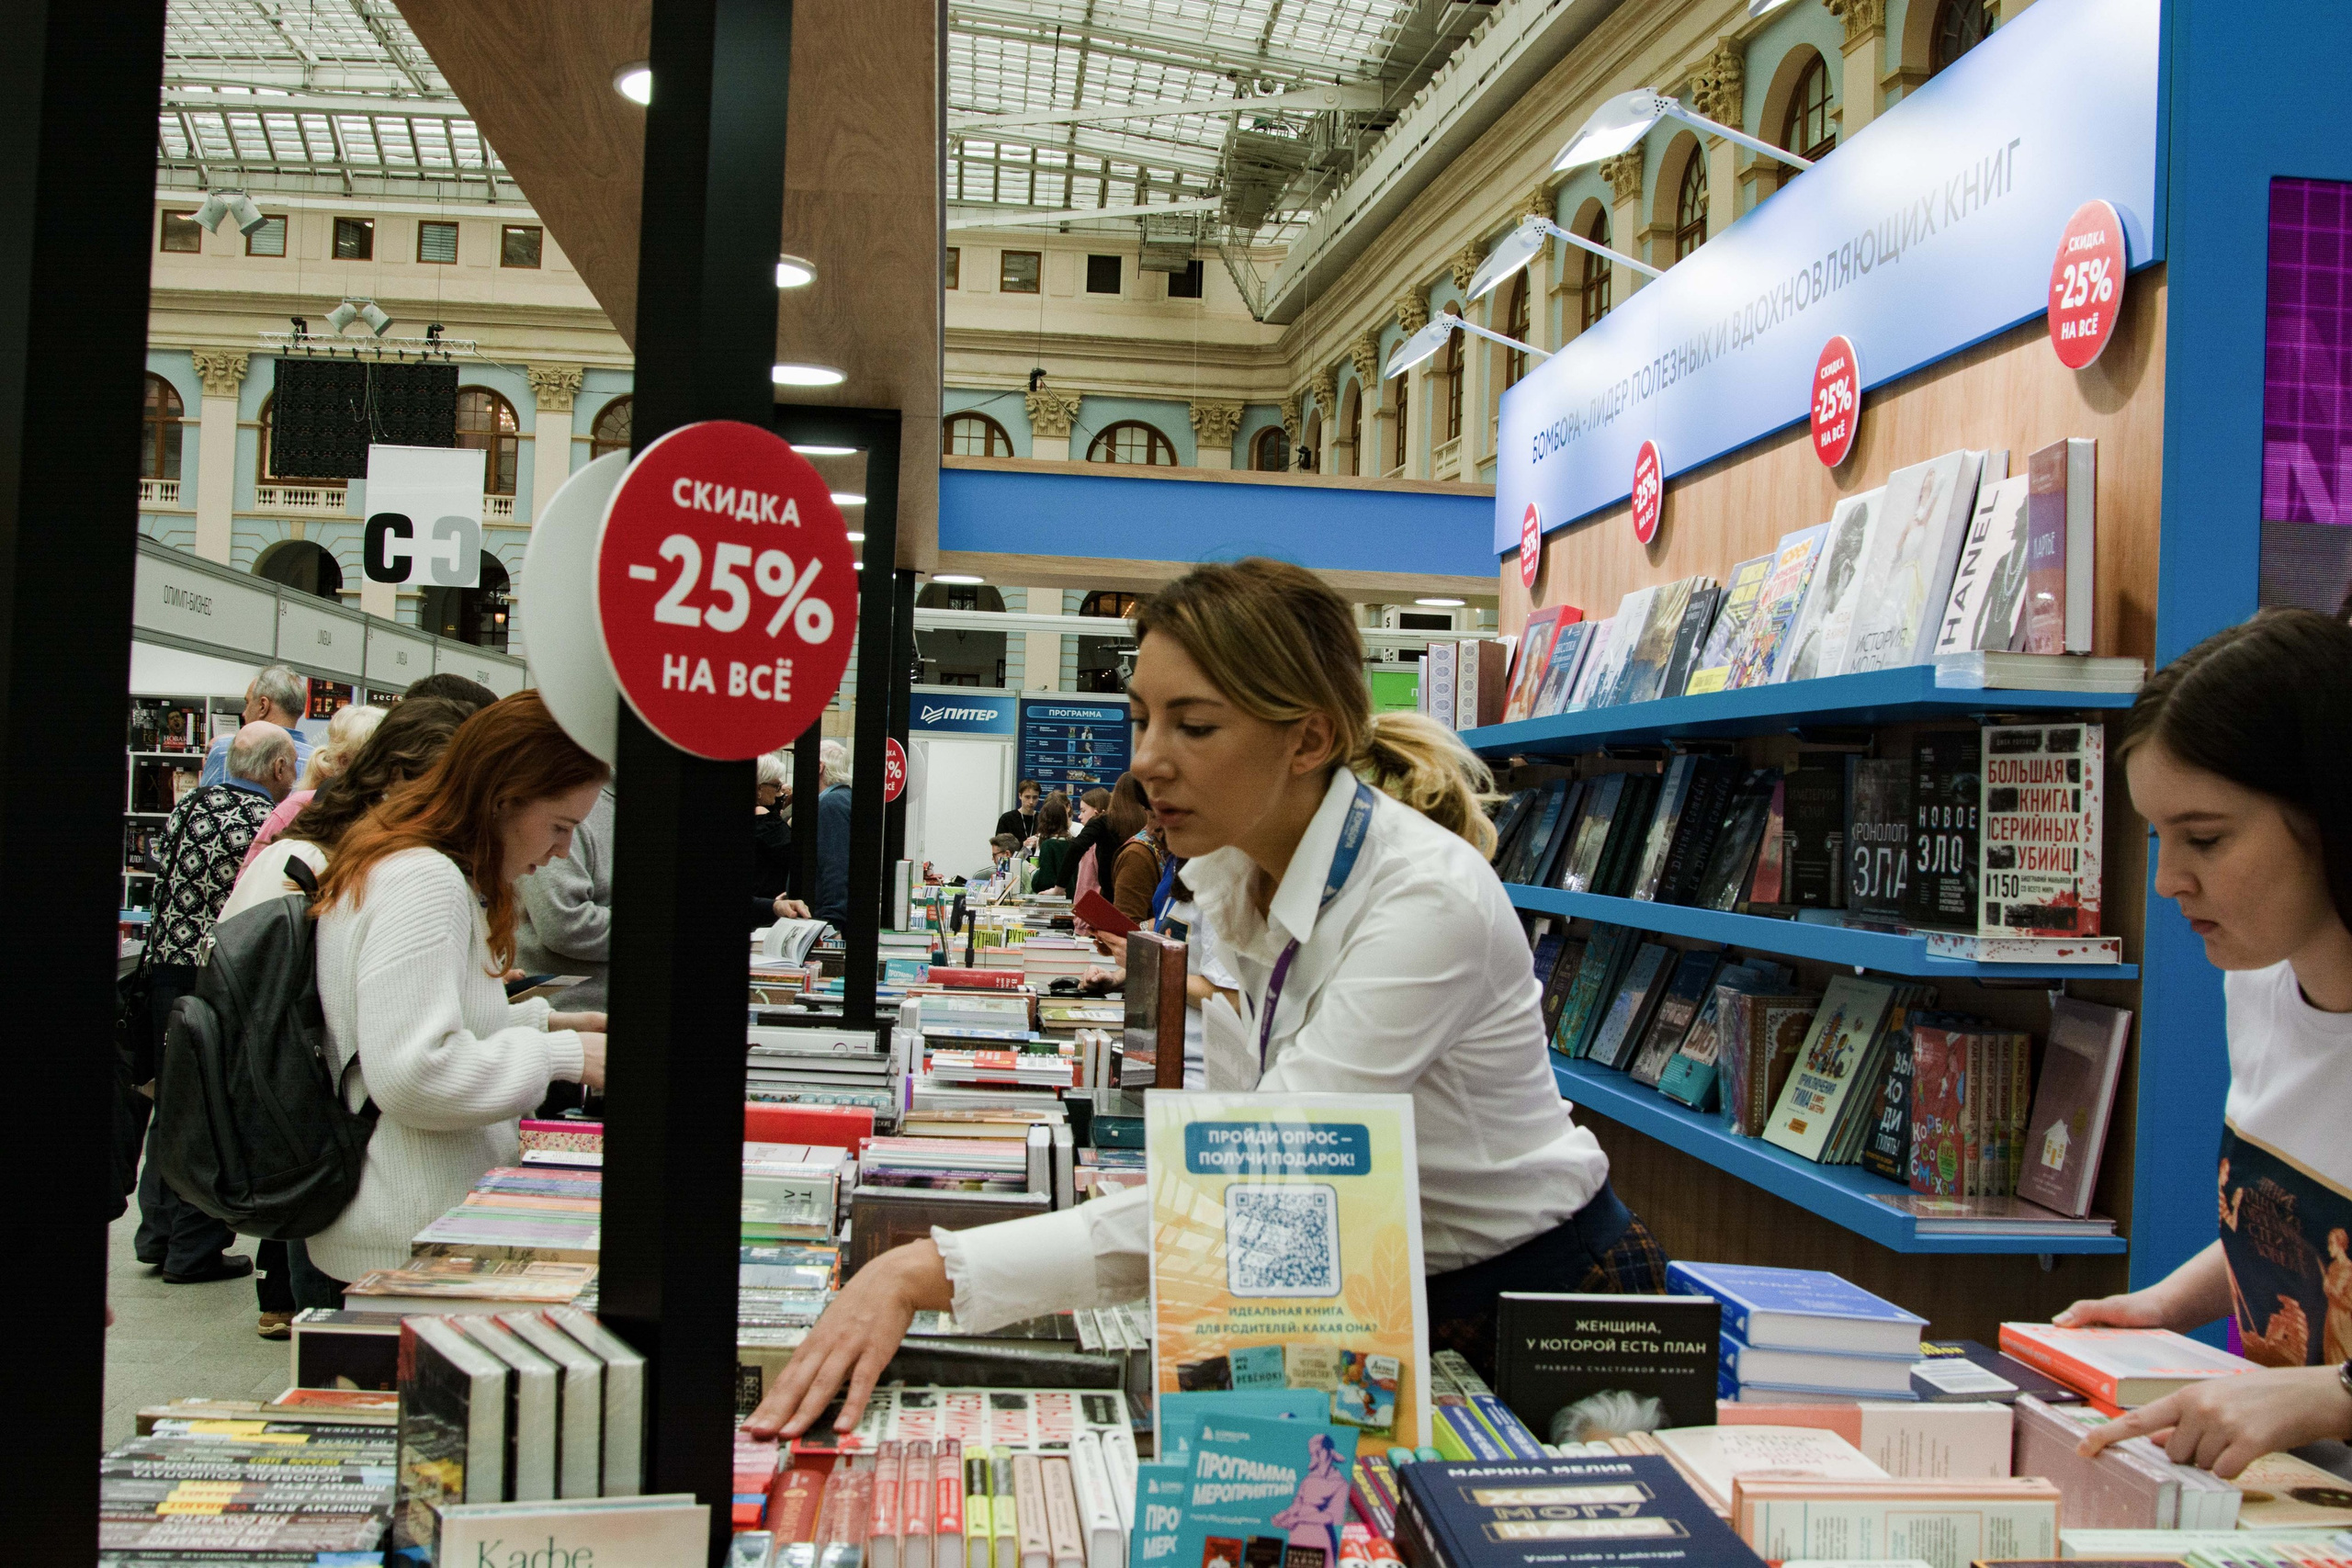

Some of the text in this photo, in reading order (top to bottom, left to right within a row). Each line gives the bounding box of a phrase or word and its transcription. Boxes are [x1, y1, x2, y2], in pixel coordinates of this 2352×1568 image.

[2069, 230, 2105, 253] СКИДКА
[2055, 256, 2112, 310] -25%
[1532, 409, 1580, 464] БОМБОРА
[1588, 378, 1629, 433] ЛИДЕР
[1632, 327, 1713, 406] ПОЛЕЗНЫХ
[1715, 319, 1727, 359] И
[1732, 189, 1937, 353] ВДОХНОВЛЯЮЩИХ
[1944, 137, 2020, 229] КНИГ
[2061, 312, 2098, 340] НА ВСЁ
[1821, 356, 1845, 379] СКИДКА
[1815, 376, 1852, 424] -25%
[1821, 420, 1845, 447] НА ВСЁ
[673, 477, 801, 528] СКИДКА
[1634, 468, 1657, 513] -25%
[1521, 529, 1536, 560] -25%
[1940, 490, 1999, 648] HANEL
[164, 584, 212, 616] ОЛИМП-БИЗНЕС
[628, 534, 834, 645] -25%
[1855, 627, 1908, 653] ИСТОРИЯ
[662, 653, 794, 702] НА ВСЁ
[944, 707, 998, 721] ПИТЕР
[1048, 709, 1102, 718] ПРОГРАММА
[1988, 760, 2064, 784] БОЛЬШАЯ
[2020, 788, 2070, 813] КНИГА
[1918, 806, 1975, 829] НОВОЕ
[1991, 814, 2079, 842] СЕРИЙНЫХ
[1917, 834, 1963, 874] ЗЛО
[2018, 843, 2072, 875] УБИЙЦ
[1853, 846, 1908, 898] ЗЛА
[1993, 874, 2019, 898] 150
[973, 930, 1001, 947] PYTHON
[1885, 1075, 1903, 1103] ХО
[1880, 1107, 1903, 1133] ДИ
[1208, 1127, 1278, 1145] ПРОЙДИ
[1282, 1130, 1338, 1145] ОПРОС
[1198, 1150, 1355, 1168] ПОЛУЧИ ПОДАРОК!
[1228, 1306, 1344, 1317] ИДЕАЛЬНАЯ КНИГА
[1195, 1324, 1220, 1334] ДЛЯ
[1303, 1324, 1342, 1333] КАКАЯ
[1345, 1324, 1377, 1333] ОНА?
[1576, 1319, 1661, 1334] ЖЕНЩИНА,
[1526, 1337, 1706, 1354] У КОТОРОЙ ЕСТЬ ПЛАН
[131, 1461, 341, 1473] ИСПОВЕДЬ СОЦИОПАТА
[131, 1470, 344, 1483] ИСПОВЕДЬ СОЦИОПАТА
[1196, 1450, 1296, 1482] ПРОГРАММА
[1448, 1463, 1634, 1477] МАРИНА МЕЛИЯ
[254, 1503, 299, 1512] ДЕТИ
[302, 1504, 372, 1513] ПОЧЕМУ
[311, 1494, 379, 1502] ПОЧЕМУ
[1145, 1505, 1182, 1531] ПРО
[1493, 1503, 1642, 1521] МОГУ
